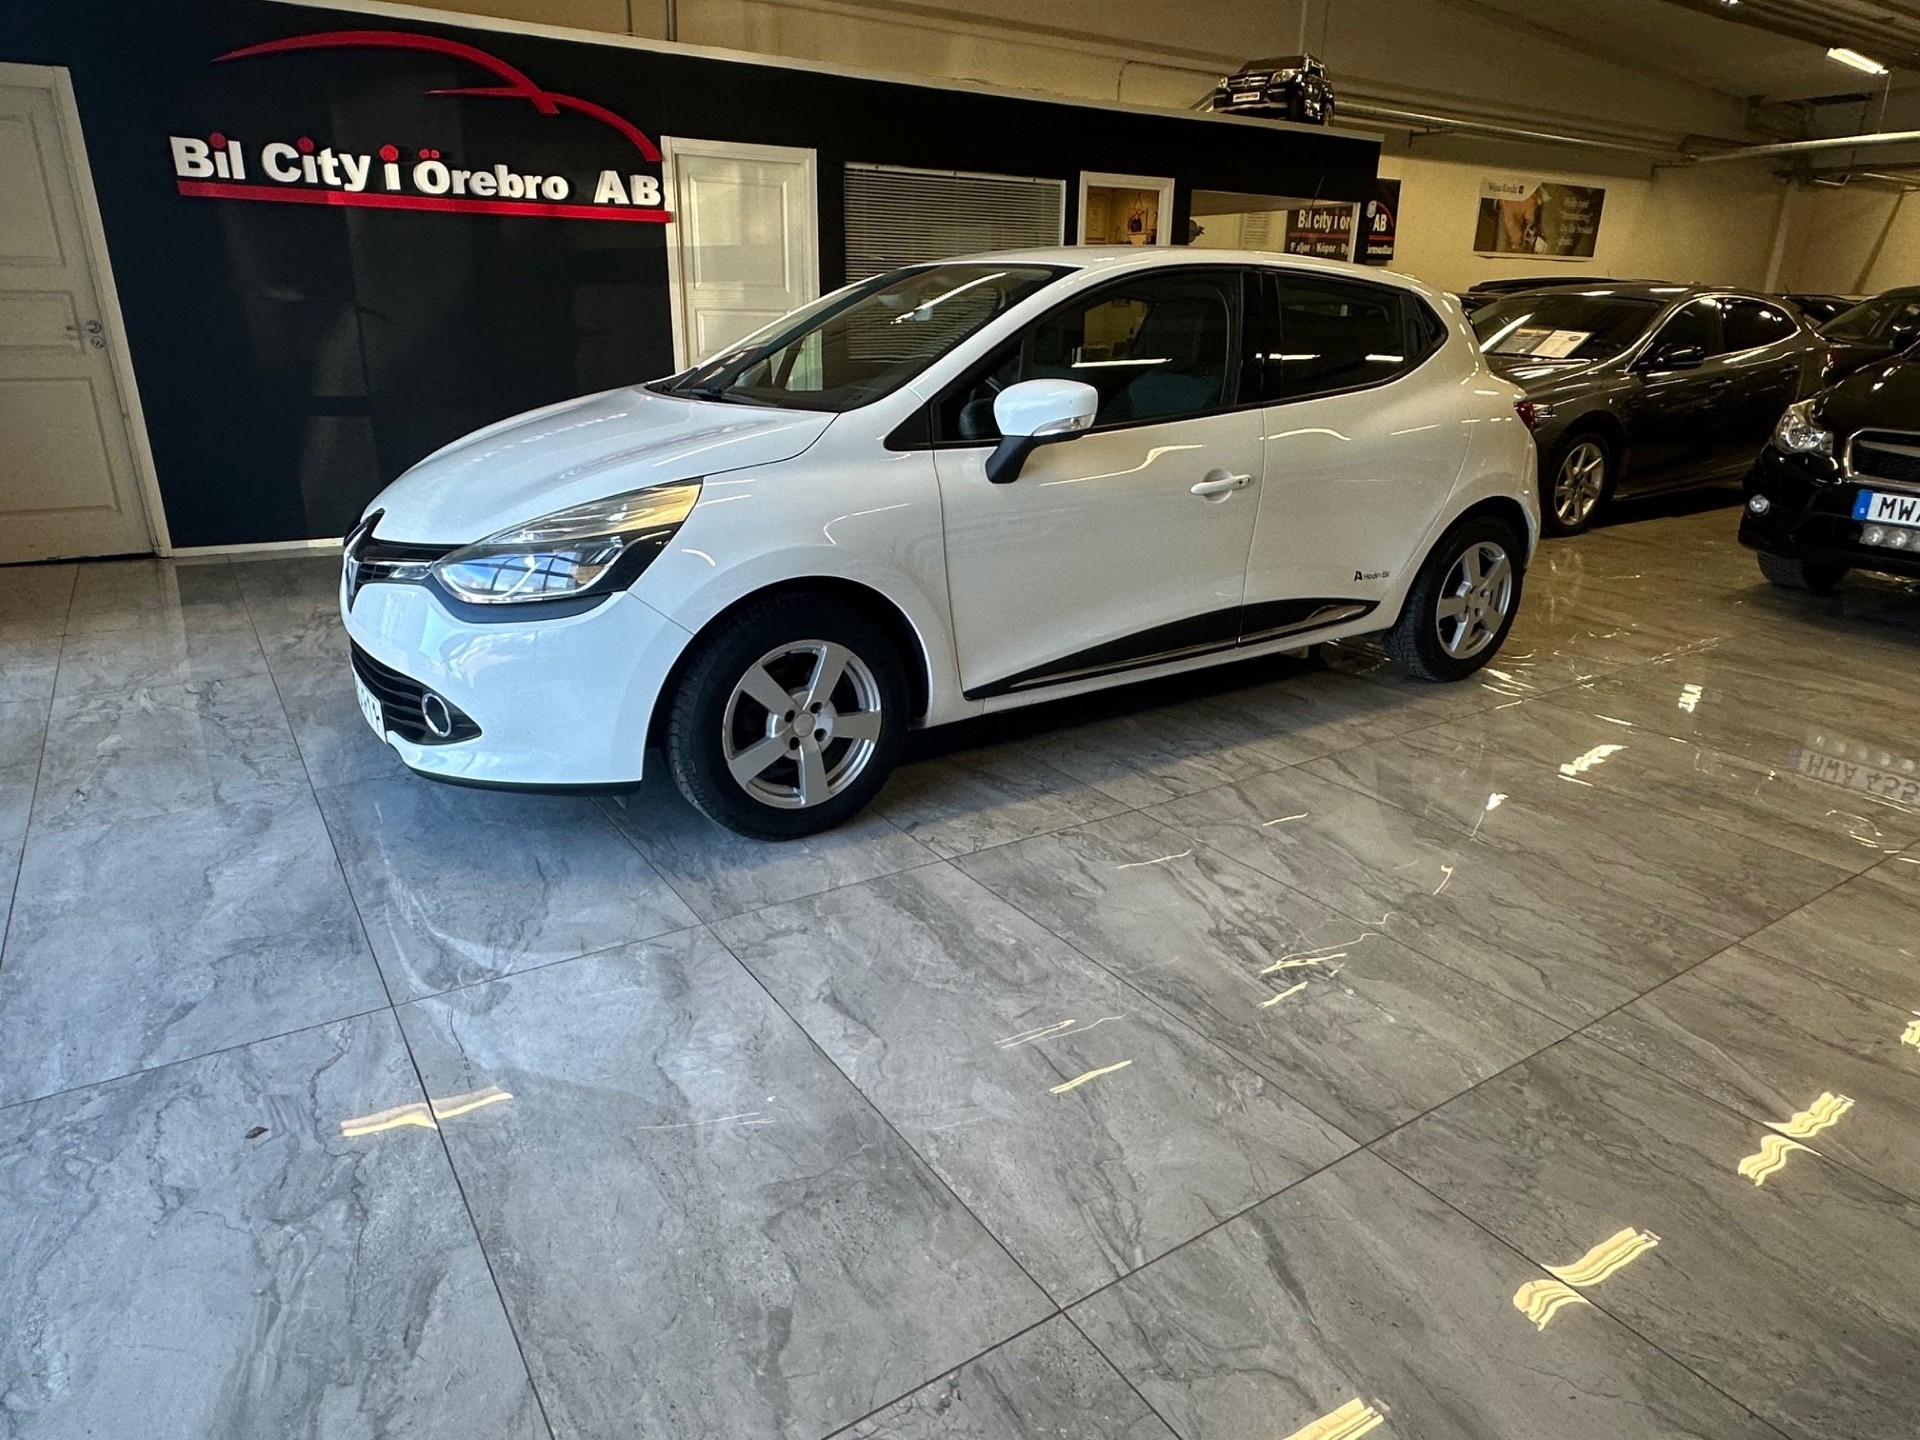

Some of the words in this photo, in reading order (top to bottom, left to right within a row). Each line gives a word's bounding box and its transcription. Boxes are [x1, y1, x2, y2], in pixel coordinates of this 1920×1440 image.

[169, 132, 246, 181] Bil
[261, 136, 371, 193] City
[379, 144, 401, 191] i
[412, 148, 569, 201] Örebro
[593, 169, 662, 206] AB
[1298, 209, 1312, 228] Bil
[1373, 214, 1387, 231] AB
